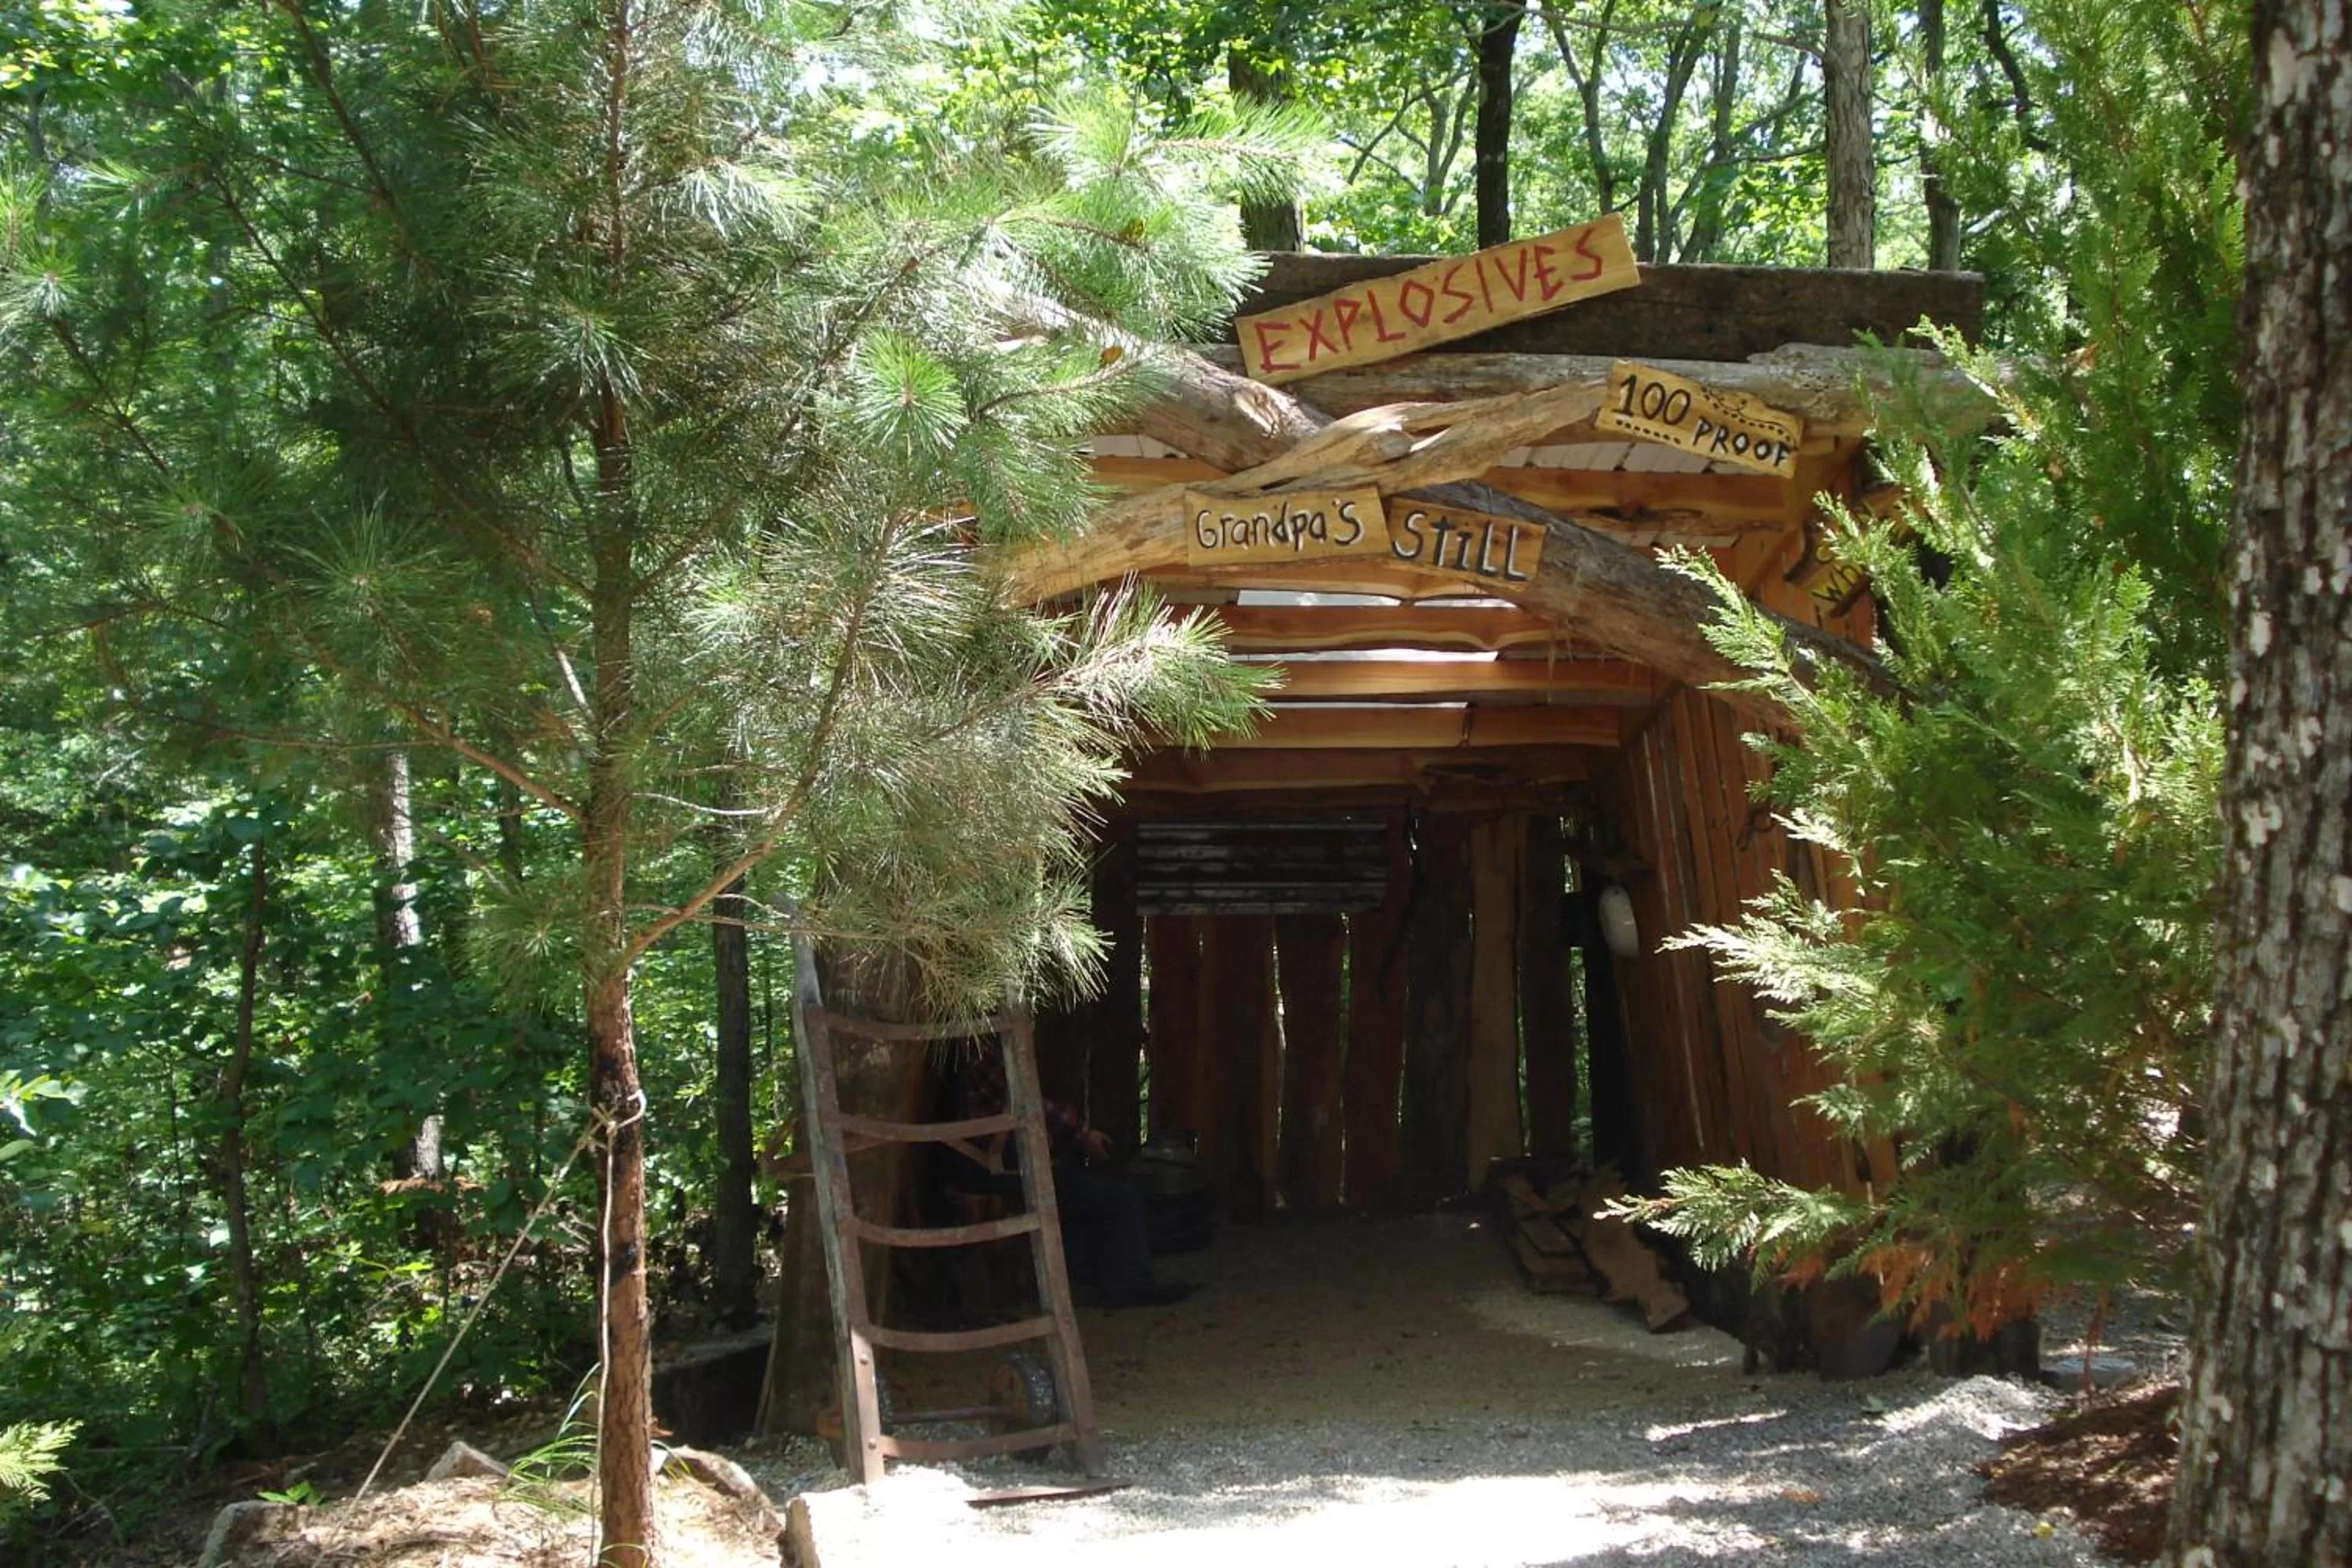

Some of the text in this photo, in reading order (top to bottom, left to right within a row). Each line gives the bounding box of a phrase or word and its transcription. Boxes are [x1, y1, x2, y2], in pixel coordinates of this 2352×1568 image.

[1254, 227, 1603, 373] EXPLOSIVES
[1612, 373, 1794, 468] 100 PROOF
